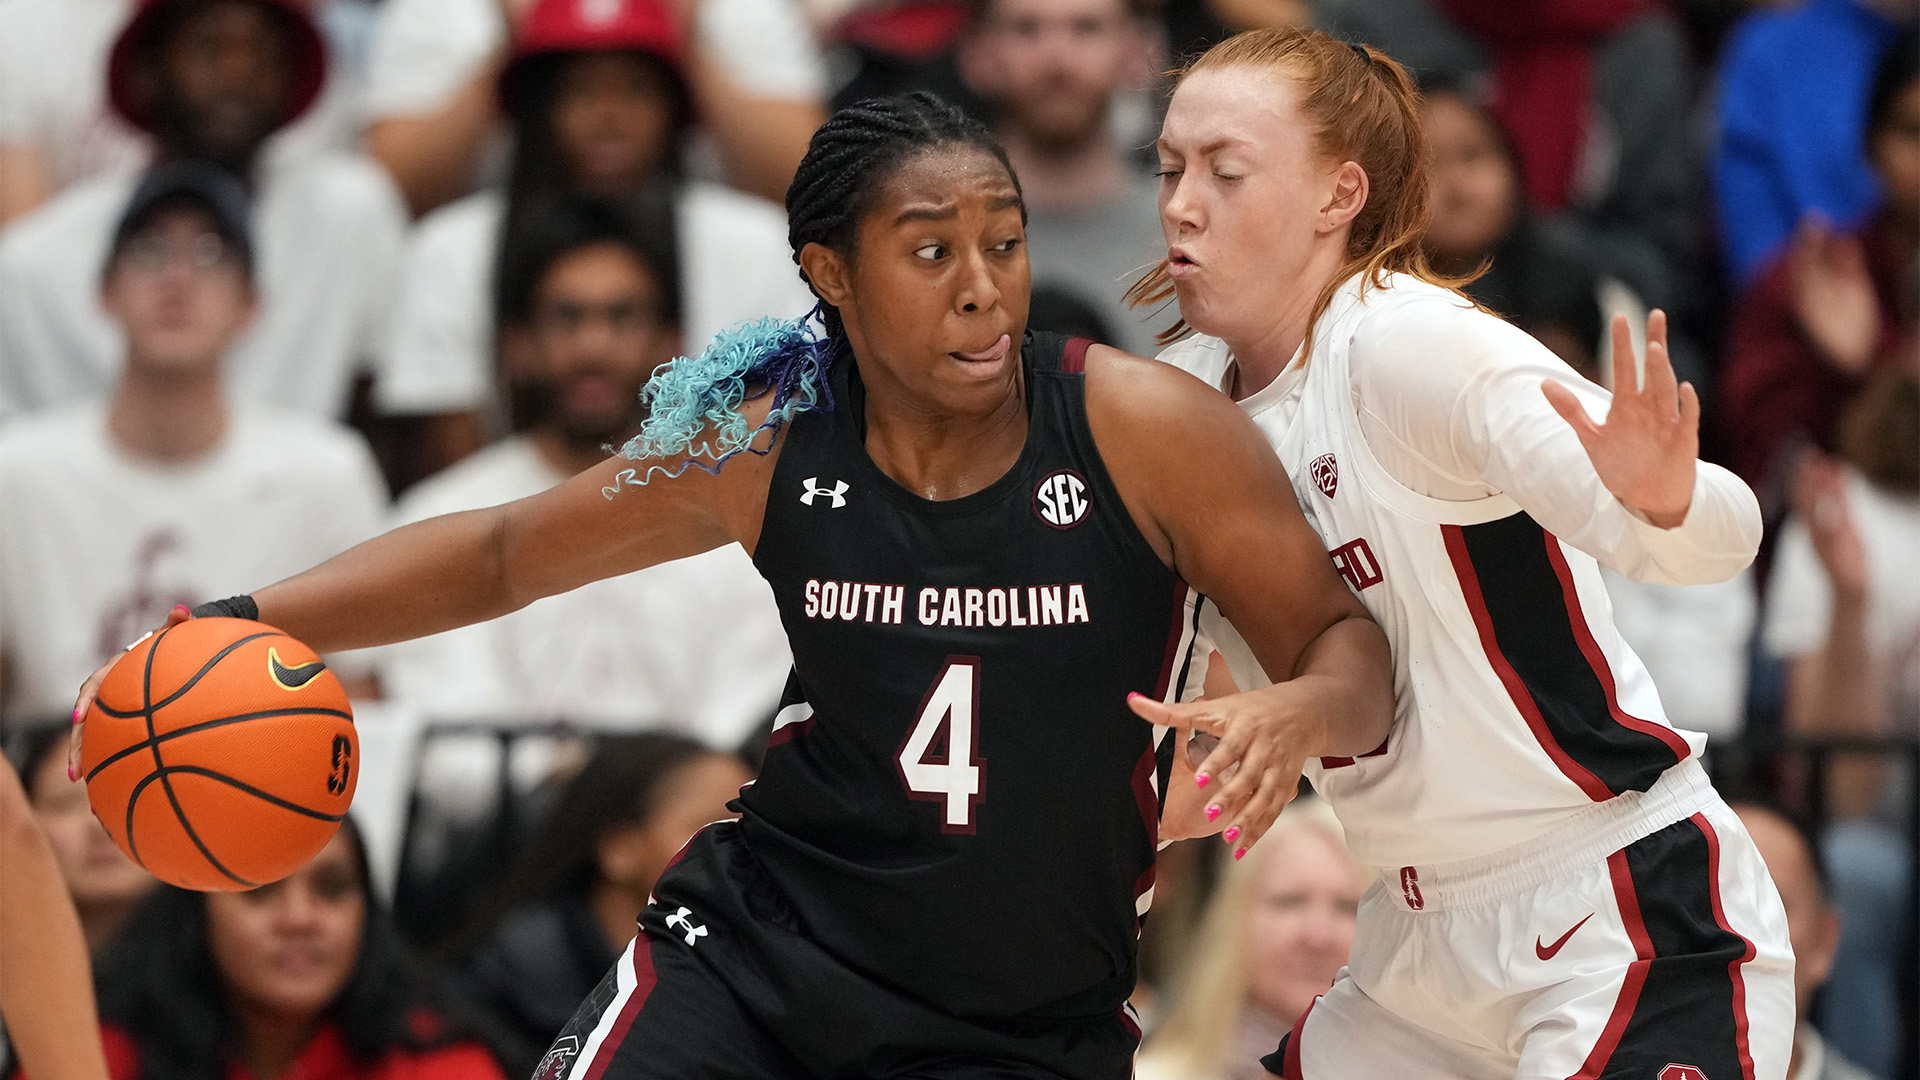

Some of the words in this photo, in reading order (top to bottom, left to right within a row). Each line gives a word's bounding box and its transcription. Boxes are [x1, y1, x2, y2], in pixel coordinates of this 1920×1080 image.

[1310, 454, 1337, 486] PAC
[1320, 472, 1336, 492] 12
[1036, 473, 1088, 525] SEC
[805, 579, 905, 624] SOUTH
[918, 584, 1091, 627] CAROLINA
[893, 655, 986, 835] 4
